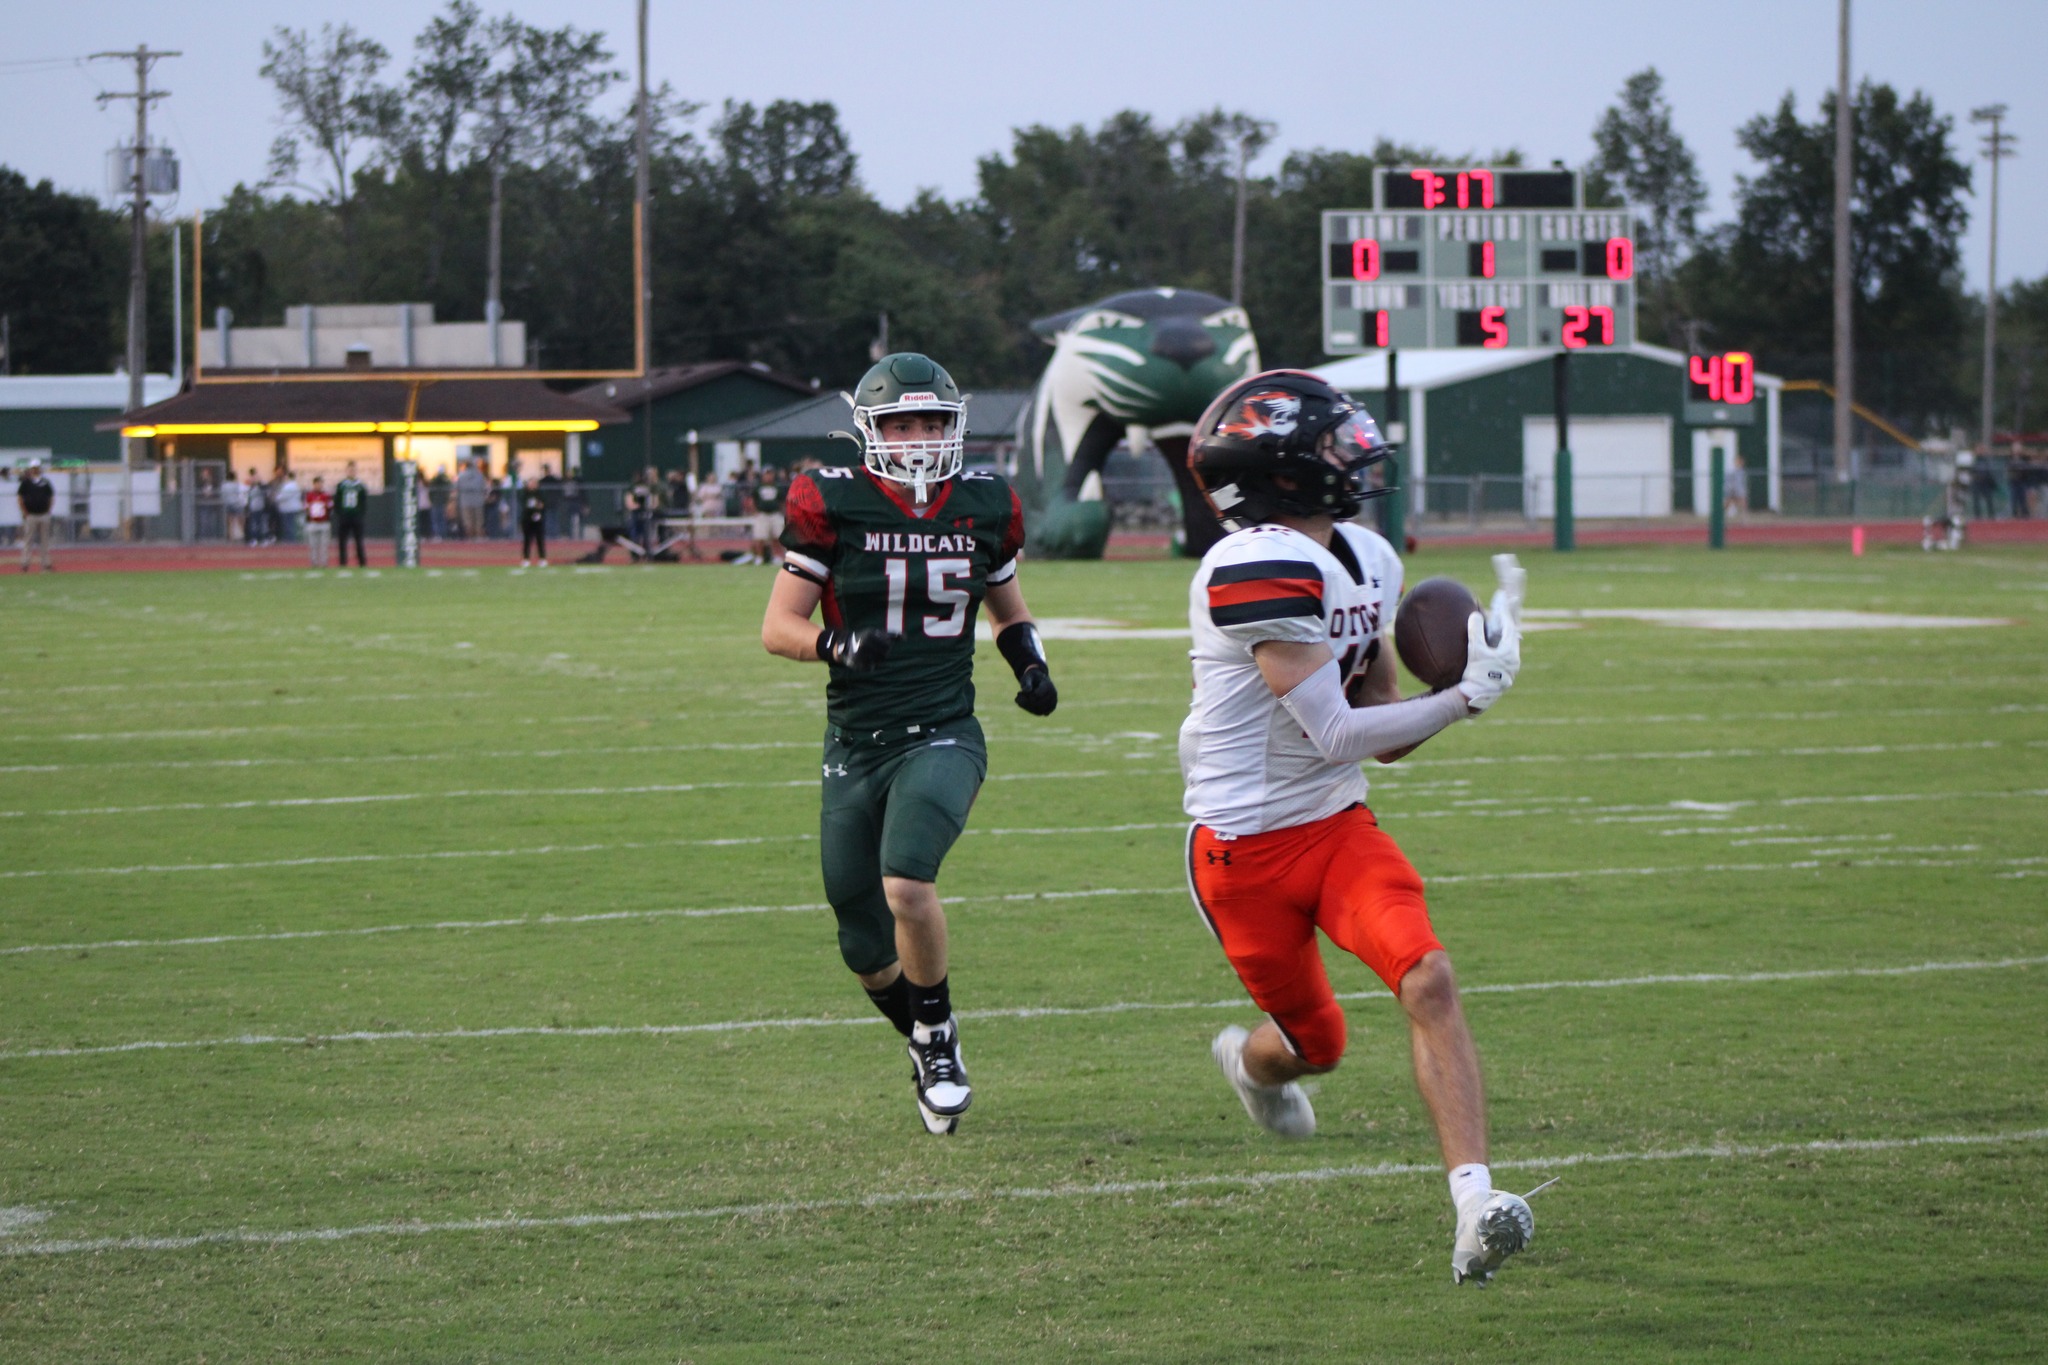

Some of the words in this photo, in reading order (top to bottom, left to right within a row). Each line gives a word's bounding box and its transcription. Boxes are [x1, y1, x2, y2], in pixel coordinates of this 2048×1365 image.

[1411, 168, 1494, 210] 7:17
[1352, 238, 1380, 282] 0
[1482, 240, 1495, 279] 1
[1606, 237, 1633, 280] 0
[1376, 309, 1389, 347] 1
[1480, 305, 1508, 349] 5
[1562, 305, 1614, 349] 27
[904, 394, 934, 402] Riddell
[1690, 351, 1754, 405] 40
[865, 532, 977, 552] WILDCATS
[885, 558, 973, 638] 15
